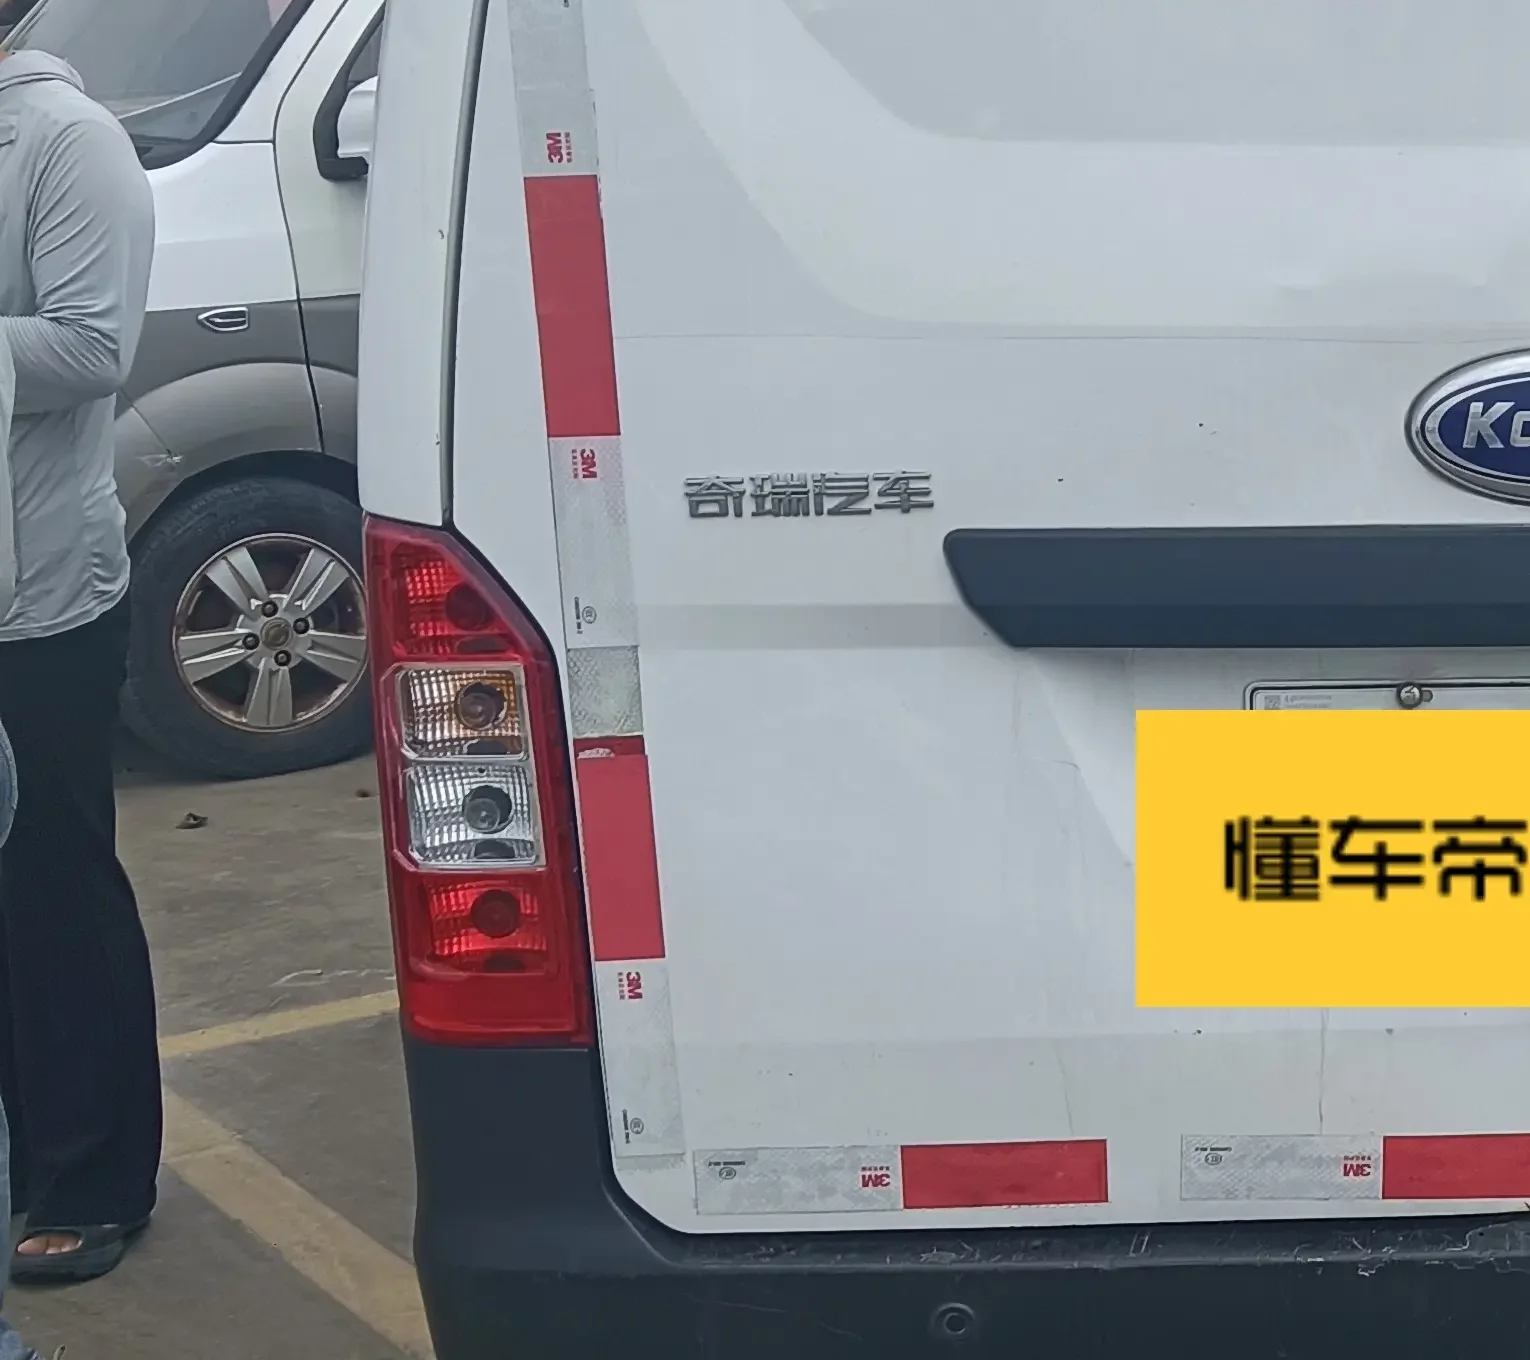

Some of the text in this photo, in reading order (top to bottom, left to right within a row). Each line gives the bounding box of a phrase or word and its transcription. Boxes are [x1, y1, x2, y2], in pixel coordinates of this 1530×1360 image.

[546, 132, 562, 163] 3M
[580, 448, 598, 479] 3M
[684, 471, 934, 518] 奇瑞汽车
[625, 971, 643, 1000] 3M
[861, 1173, 890, 1187] 3M
[1343, 1163, 1371, 1177] 3M
